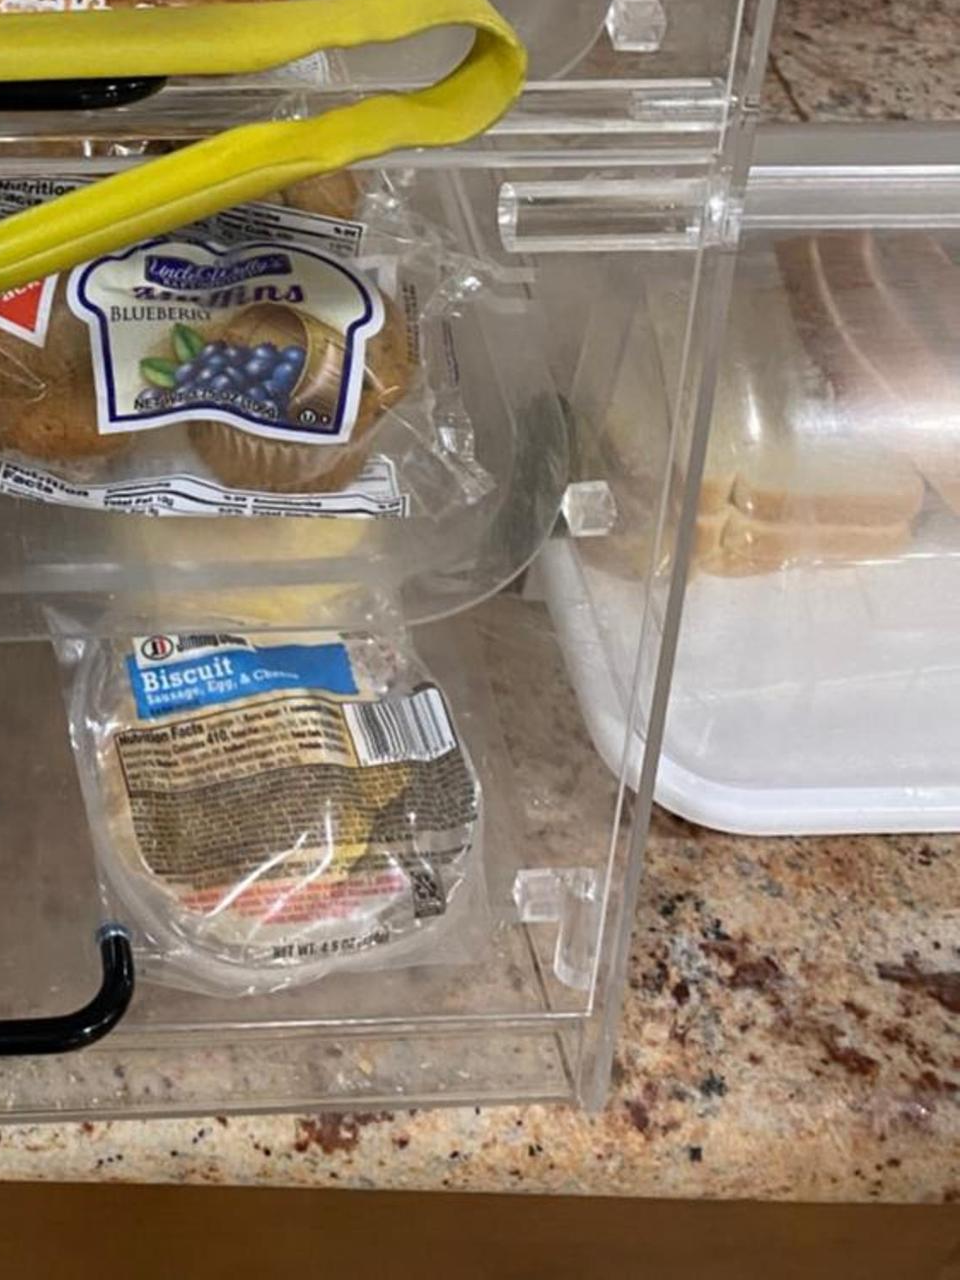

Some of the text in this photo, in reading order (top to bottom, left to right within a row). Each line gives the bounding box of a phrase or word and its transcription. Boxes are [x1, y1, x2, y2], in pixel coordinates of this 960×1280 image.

[110, 306, 213, 323] BLUEBERRY
[2, 469, 54, 494] Facts
[141, 656, 234, 693] Biscuit
[206, 677, 238, 694] Egg,
[170, 722, 205, 740] Facts
